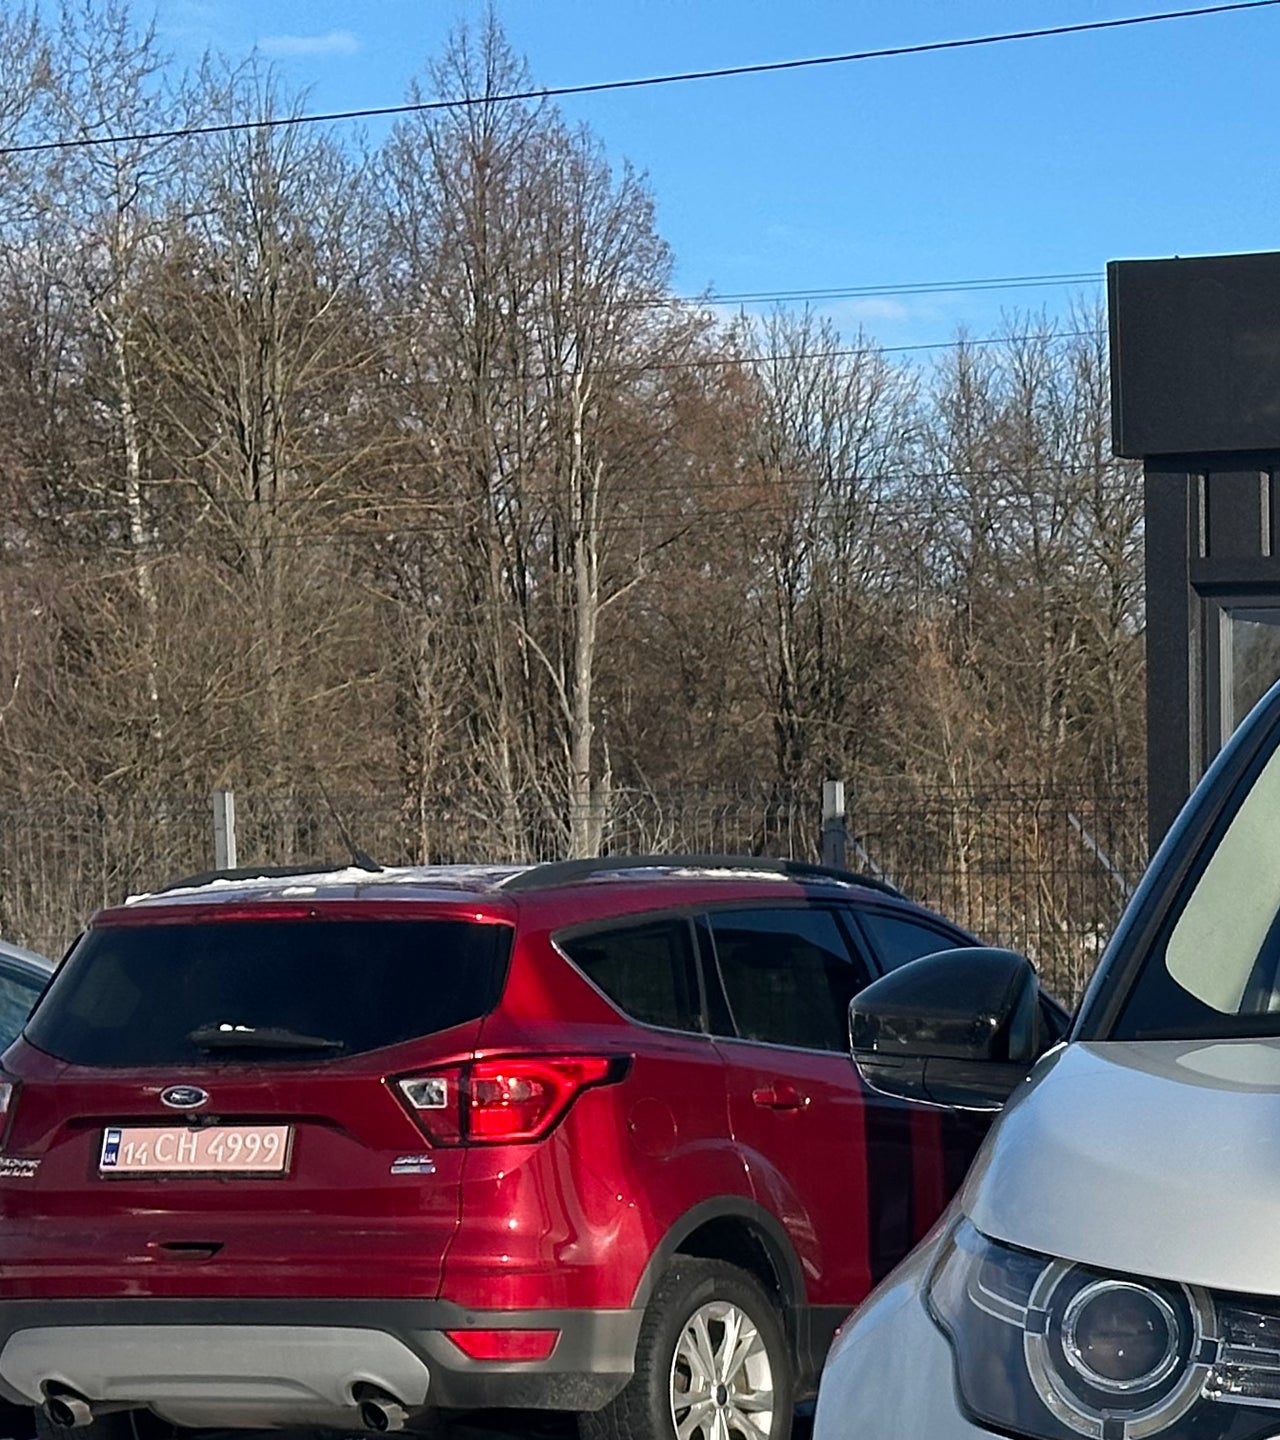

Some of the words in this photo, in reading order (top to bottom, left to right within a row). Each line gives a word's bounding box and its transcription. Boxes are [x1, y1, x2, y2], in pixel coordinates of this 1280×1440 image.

[123, 1142, 148, 1165] 14
[154, 1132, 199, 1164] CH
[207, 1132, 280, 1163] 4999
